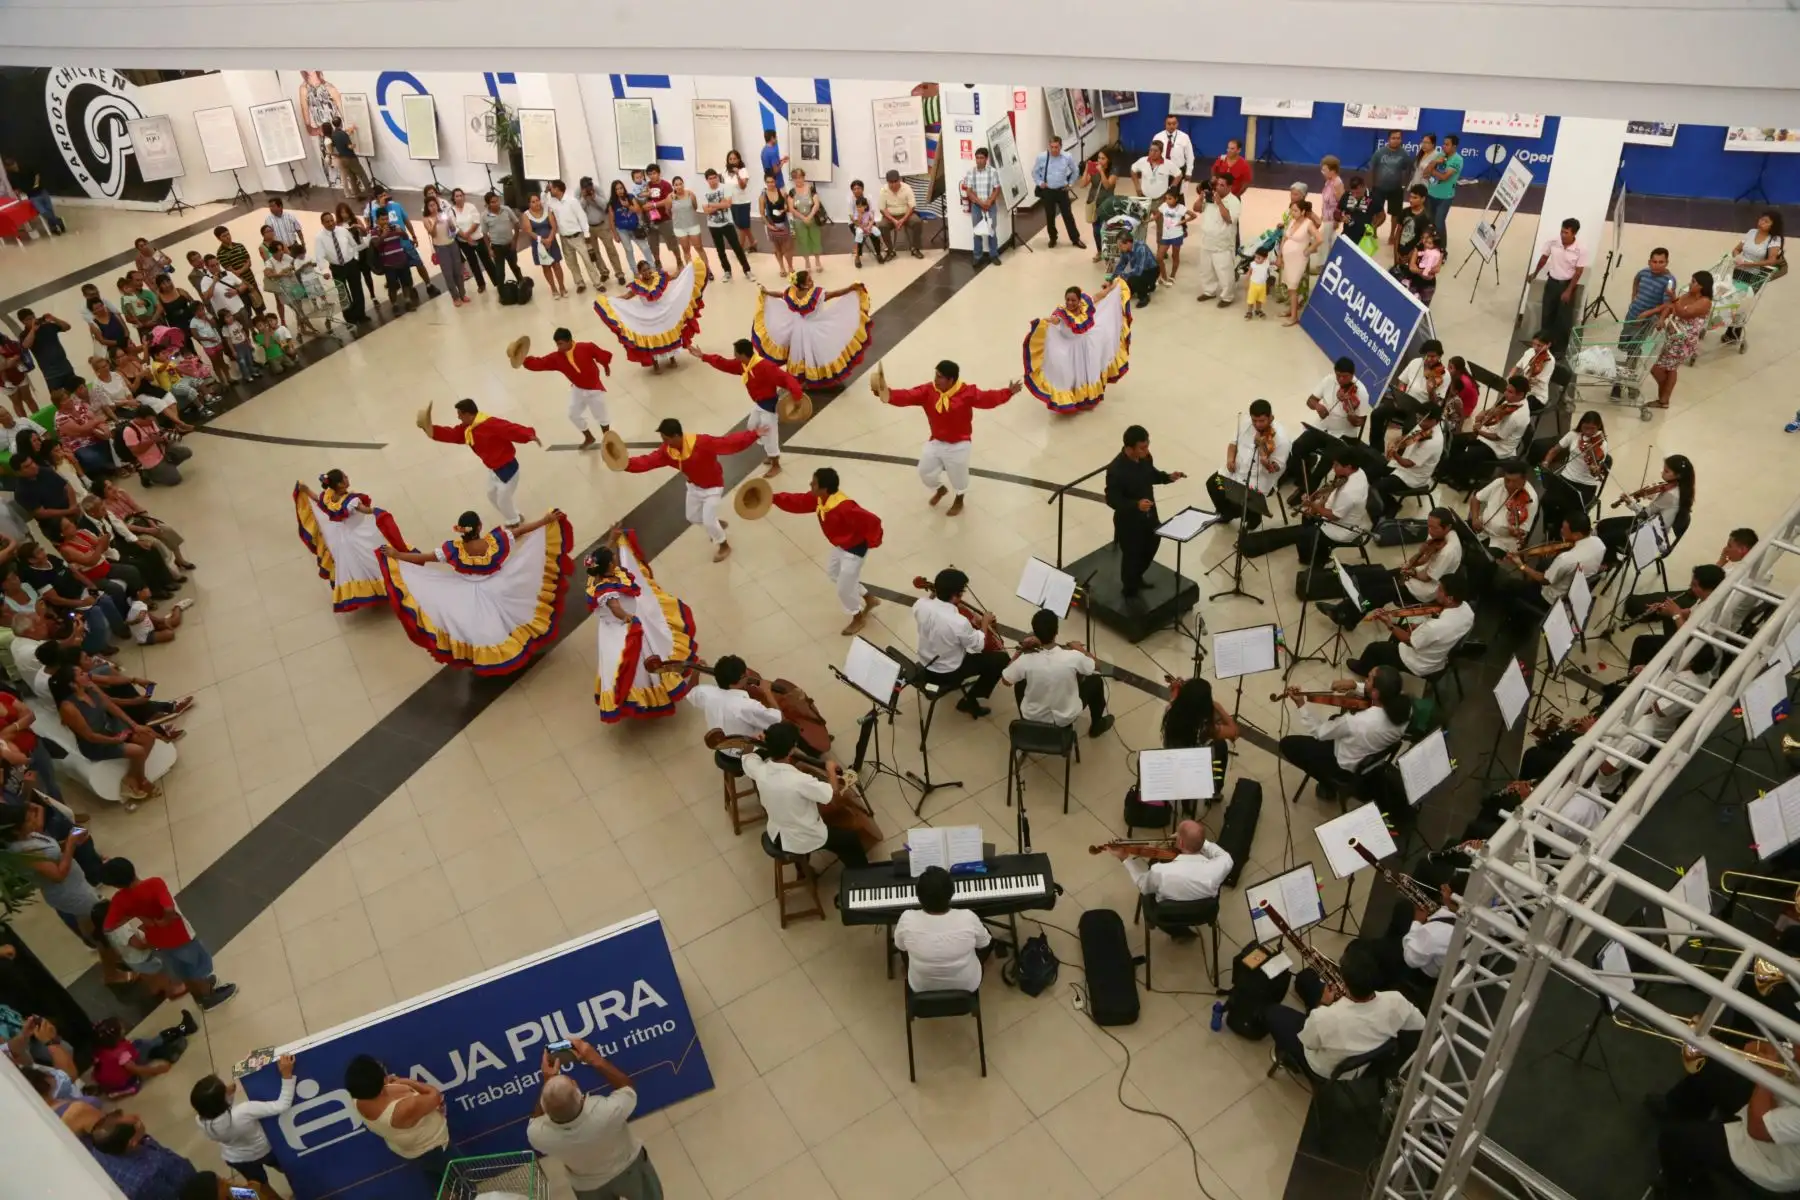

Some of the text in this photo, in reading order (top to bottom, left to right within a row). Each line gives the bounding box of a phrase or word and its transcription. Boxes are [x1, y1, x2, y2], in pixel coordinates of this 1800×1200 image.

[51, 92, 89, 183] PARDOS
[1461, 147, 1478, 156] en:
[1337, 278, 1401, 352] CAJA PIURA
[1343, 311, 1369, 343] Trabajando
[1376, 348, 1391, 366] ritmo
[409, 979, 669, 1093] AJA PIURA
[455, 1019, 676, 1112] Trabajano tu ritmo
